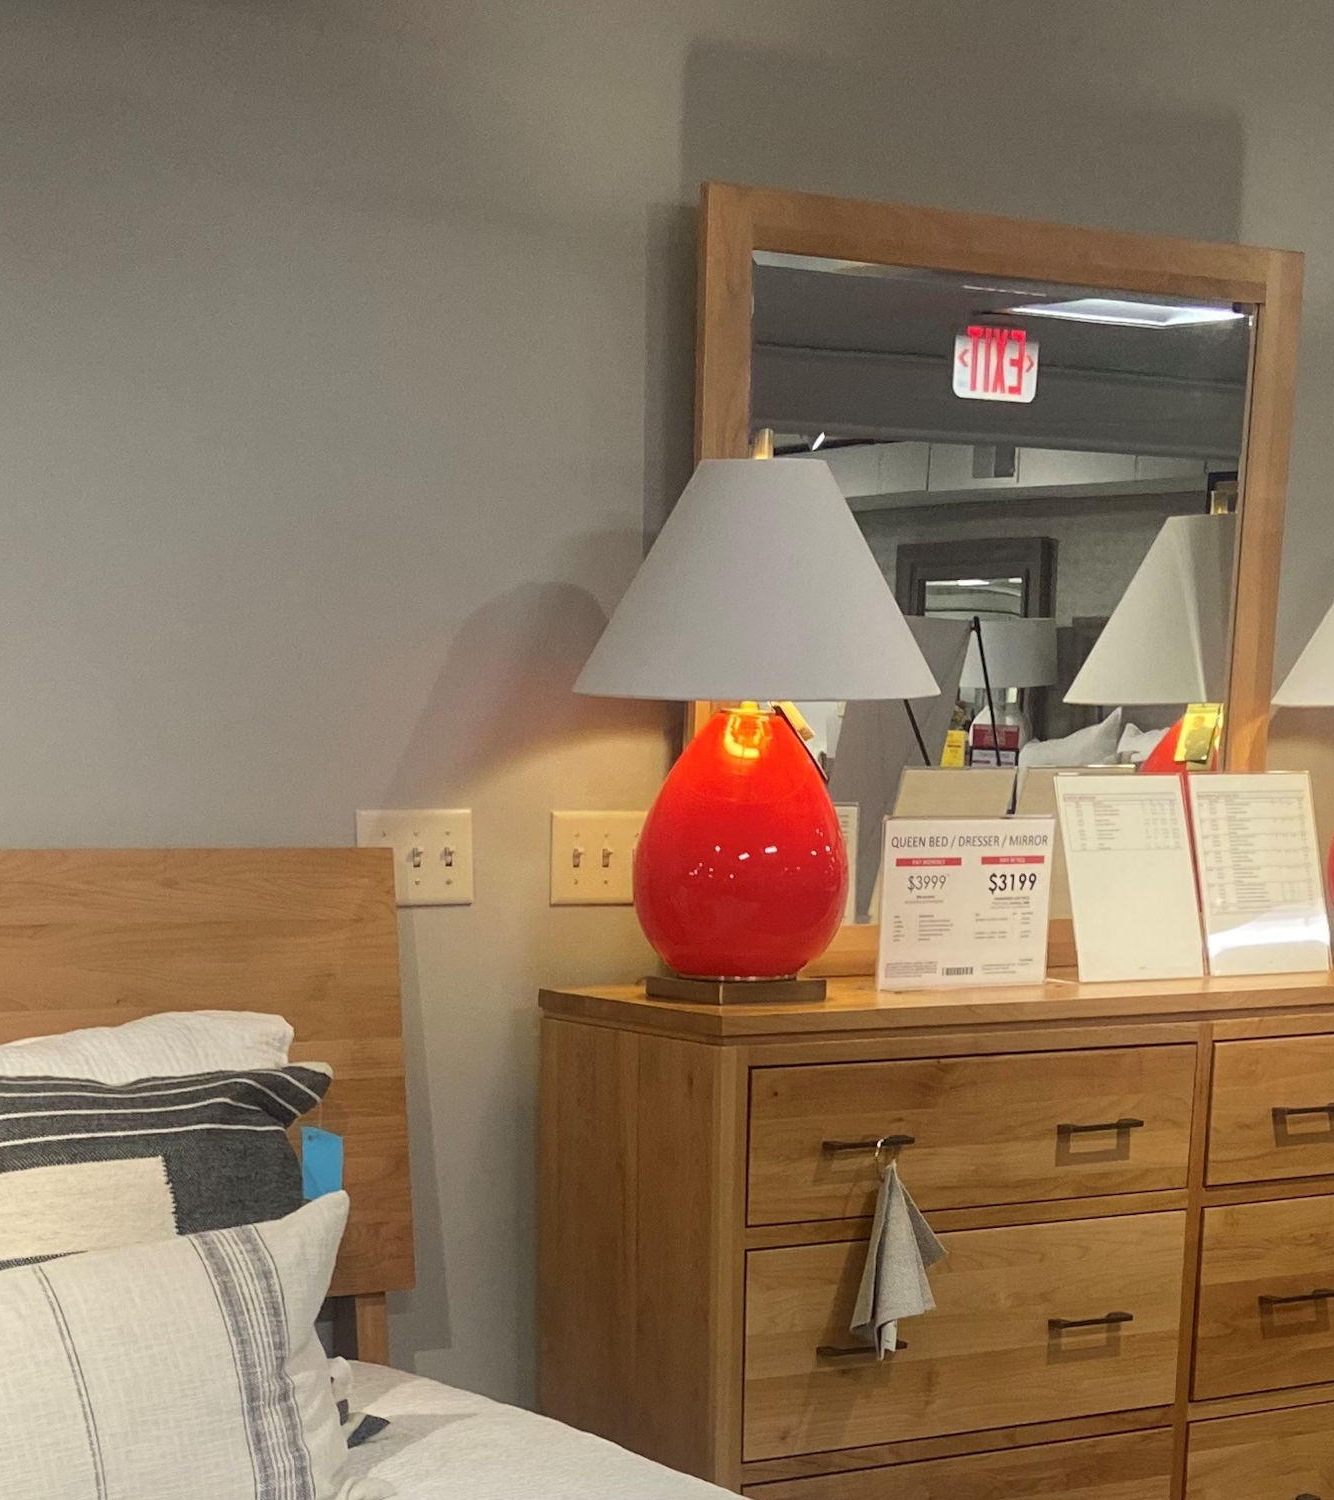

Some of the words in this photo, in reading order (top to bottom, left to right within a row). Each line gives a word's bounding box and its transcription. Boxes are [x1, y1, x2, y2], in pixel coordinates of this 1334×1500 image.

[892, 836, 926, 848] QUEEN
[929, 836, 948, 847] BED
[959, 836, 999, 847] DRESSER
[1009, 835, 1048, 846] MIRROR
[907, 875, 946, 893] $3999
[988, 873, 1037, 894] $3199
